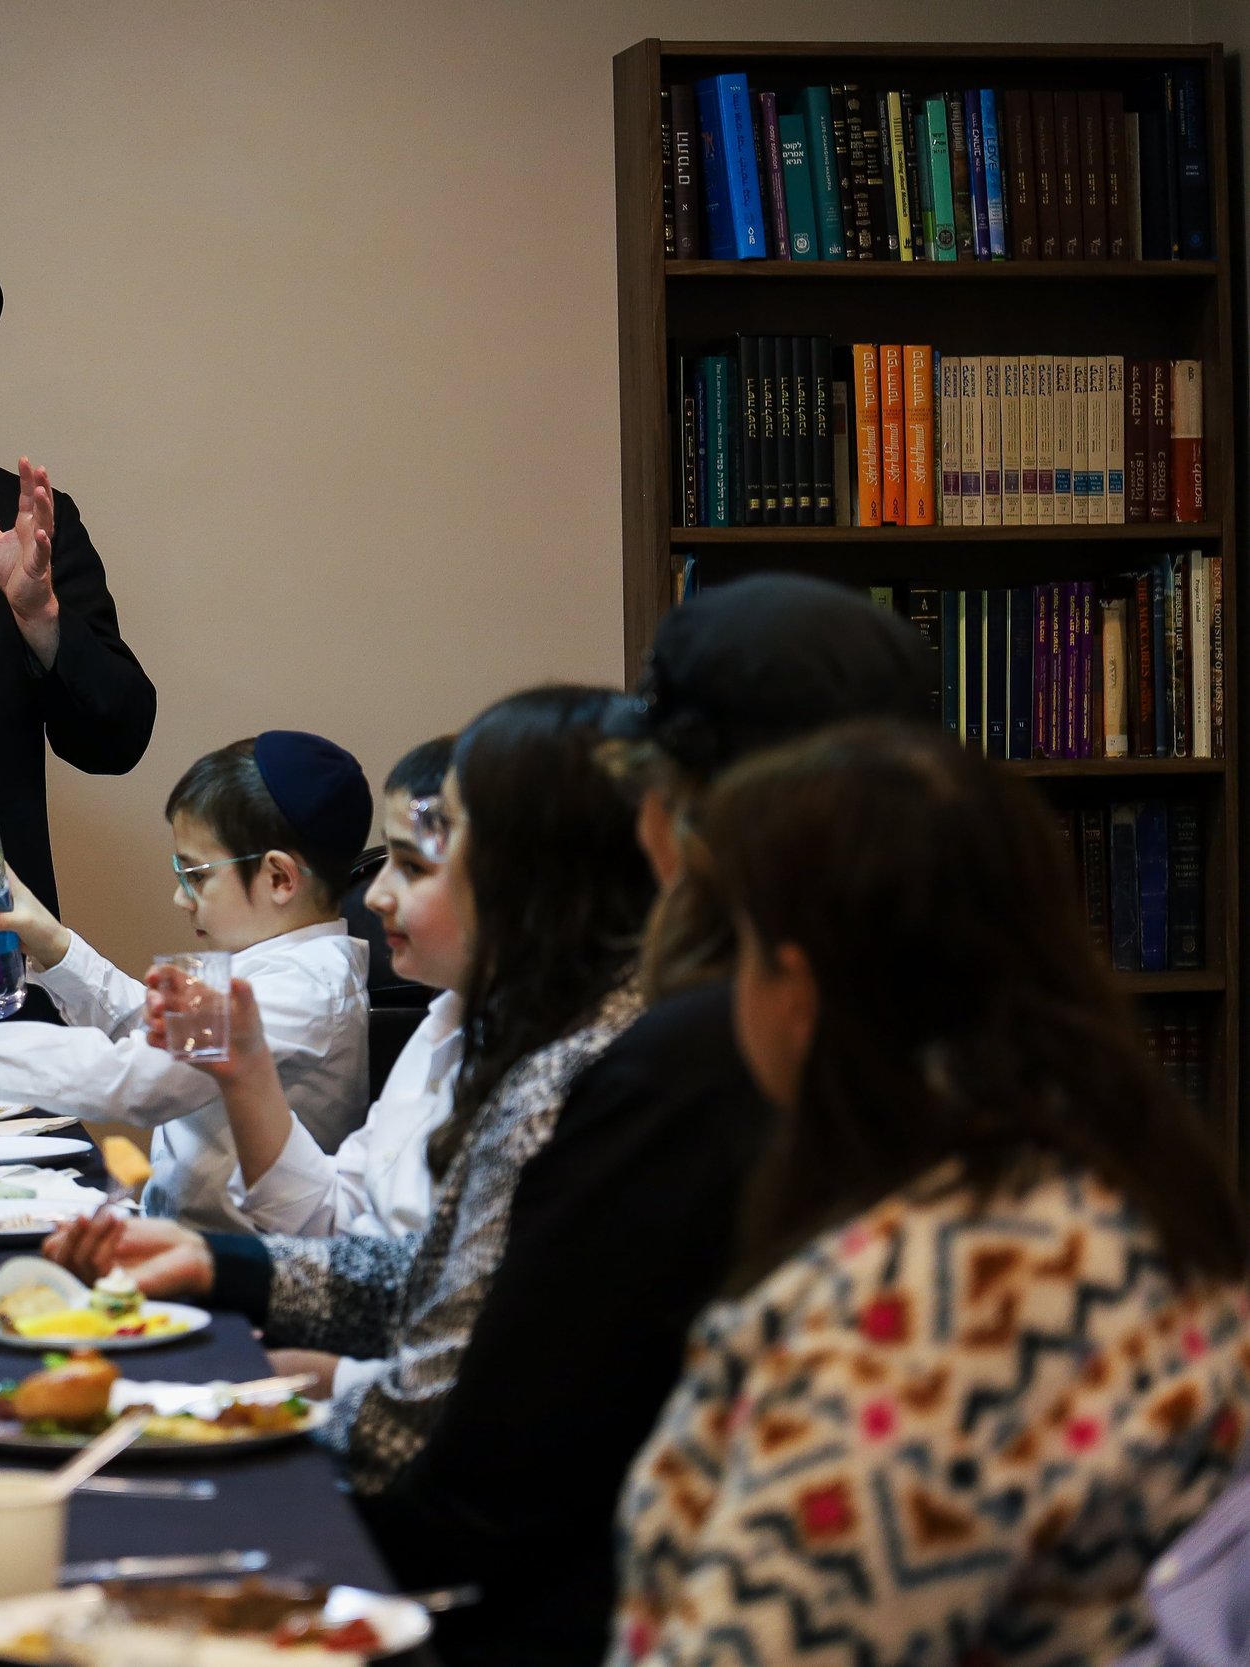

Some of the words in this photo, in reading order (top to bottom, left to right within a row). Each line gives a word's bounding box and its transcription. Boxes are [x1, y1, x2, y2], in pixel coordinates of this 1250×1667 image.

[770, 142, 778, 169] solution
[782, 141, 802, 150] לקוטי
[782, 150, 804, 158] אמרים
[820, 121, 831, 166] LIFE-CHANGING
[971, 128, 982, 156] לאהוב
[676, 131, 690, 185] התמים
[863, 352, 874, 374] ספר
[886, 349, 897, 371] ספר
[912, 351, 923, 372] ספר
[746, 378, 756, 406] דרשה
[764, 378, 772, 407] דרשה
[780, 376, 789, 406] דרשה
[798, 376, 806, 406] דרשה
[817, 377, 825, 405] דרשה
[962, 365, 970, 397] בראשית
[986, 365, 994, 397] בראשית
[1022, 363, 1030, 397] בראשית
[1038, 363, 1046, 397] בראשית
[1056, 364, 1064, 392] תהלים
[1074, 366, 1083, 393] תהלים
[1090, 364, 1098, 392] תהלים
[1109, 364, 1117, 392] תהלים
[1130, 382, 1141, 416] מלכים
[1152, 383, 1164, 416] מלכים
[744, 408, 757, 438] לשבת
[761, 409, 773, 438] לשבת
[776, 407, 790, 437] לשבת
[794, 408, 806, 437] לשבת
[814, 407, 825, 437] לשבת
[1214, 567, 1220, 578] IN
[1137, 581, 1147, 605] THE
[1138, 607, 1150, 677] MACCABEES
[1213, 603, 1222, 658] FOOTSTEPS
[1215, 661, 1222, 674] OF
[1215, 676, 1223, 711] MOSES
